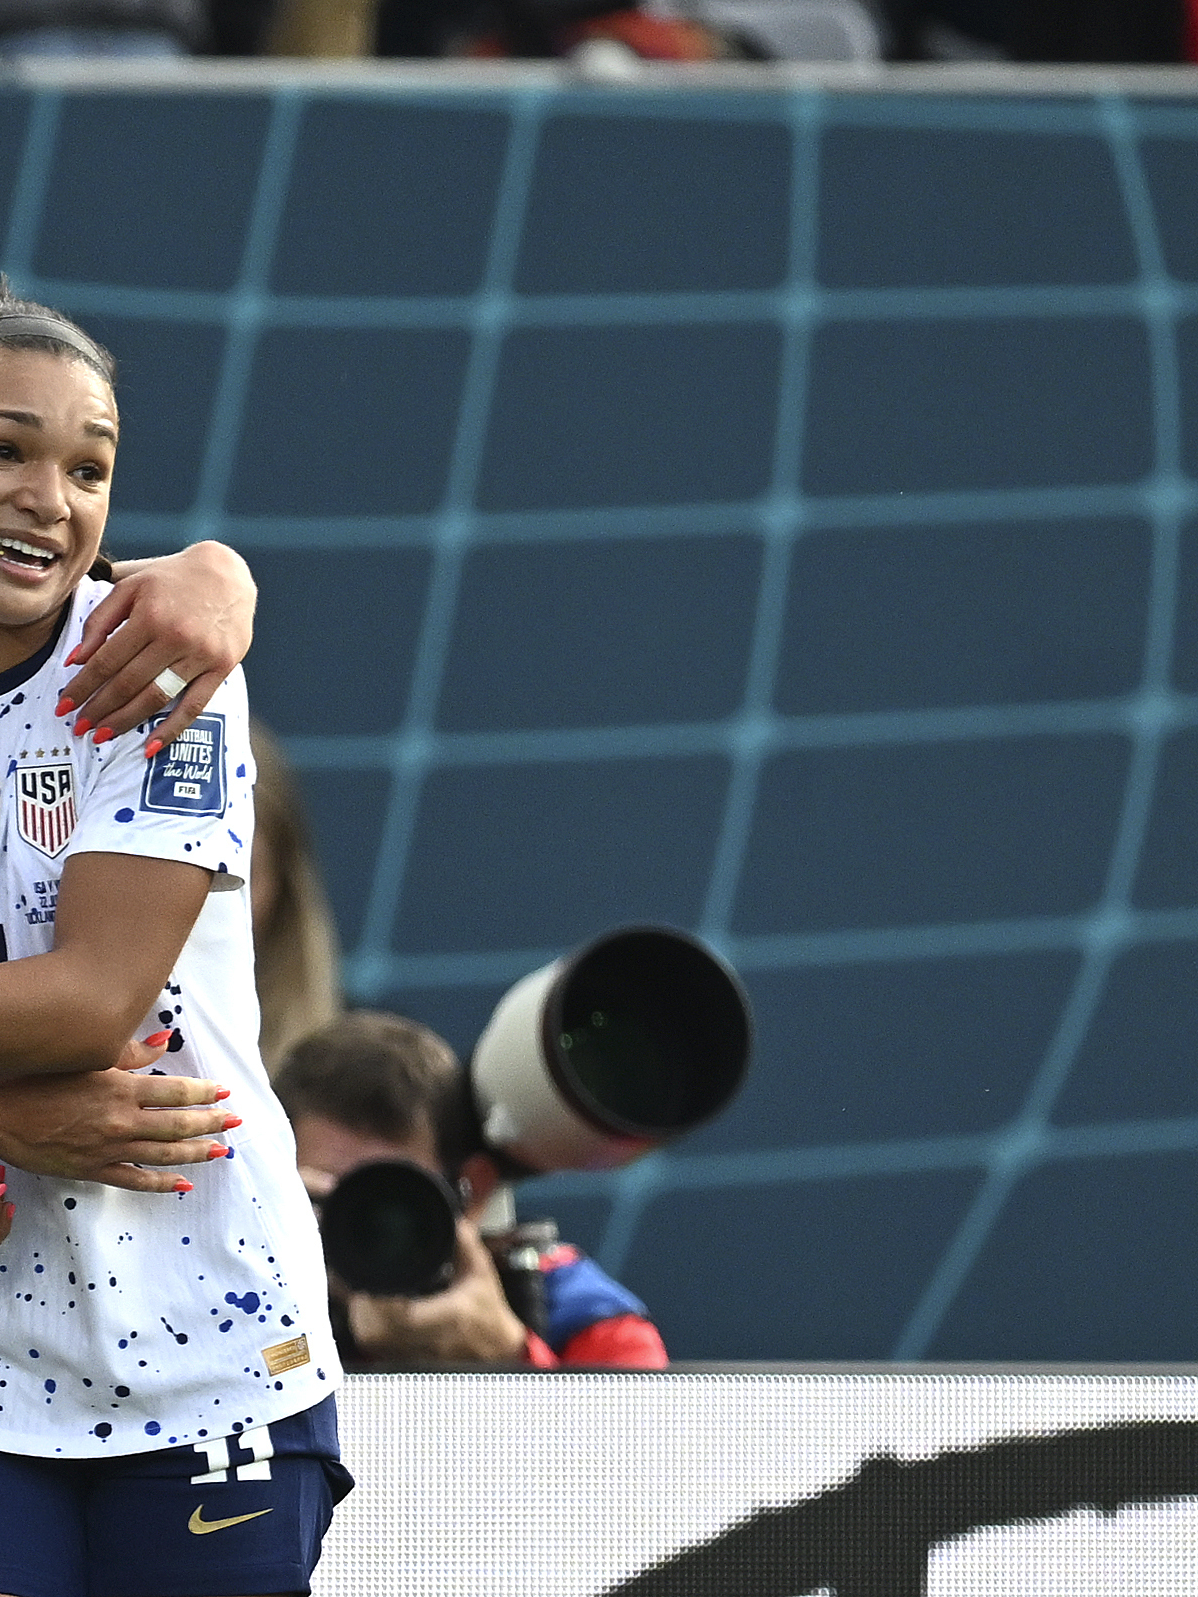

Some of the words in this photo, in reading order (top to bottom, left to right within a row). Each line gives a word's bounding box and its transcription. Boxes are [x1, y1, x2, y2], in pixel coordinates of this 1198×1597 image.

[176, 728, 213, 744] OOTBALL
[169, 743, 213, 764] UNITES
[163, 762, 183, 777] the
[183, 763, 213, 783] World
[21, 769, 71, 805] USA
[179, 785, 196, 795] FIFA
[190, 1424, 275, 1485] 11
